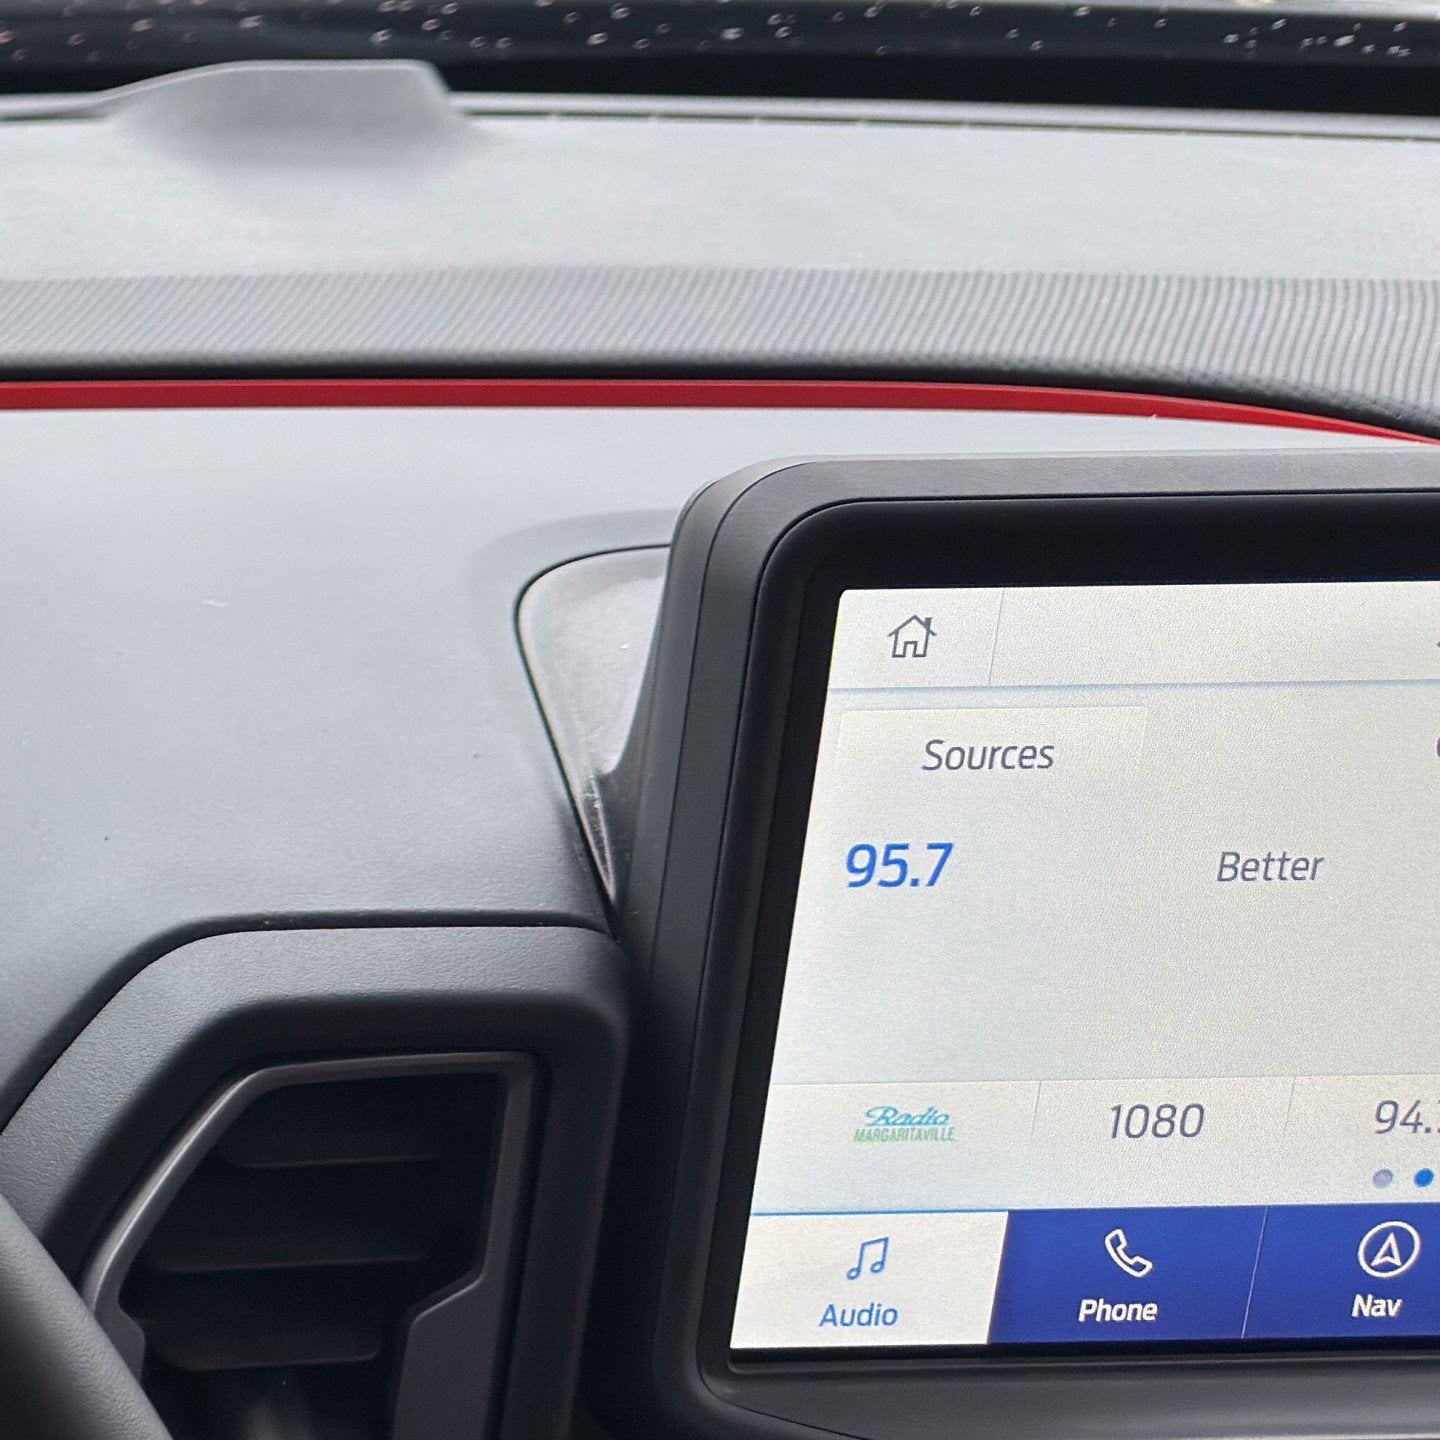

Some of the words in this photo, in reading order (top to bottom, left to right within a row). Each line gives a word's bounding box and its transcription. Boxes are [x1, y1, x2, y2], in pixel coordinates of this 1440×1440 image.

[921, 738, 1055, 772] Sources
[846, 842, 954, 888] 95.7
[1216, 851, 1325, 883] Better
[864, 1105, 951, 1126] Radio
[1111, 1103, 1205, 1139] 1080
[1375, 1100, 1440, 1134] 94.
[818, 1301, 899, 1328] Audio
[1077, 1298, 1158, 1323] Phone
[1351, 1293, 1403, 1318] Nav
